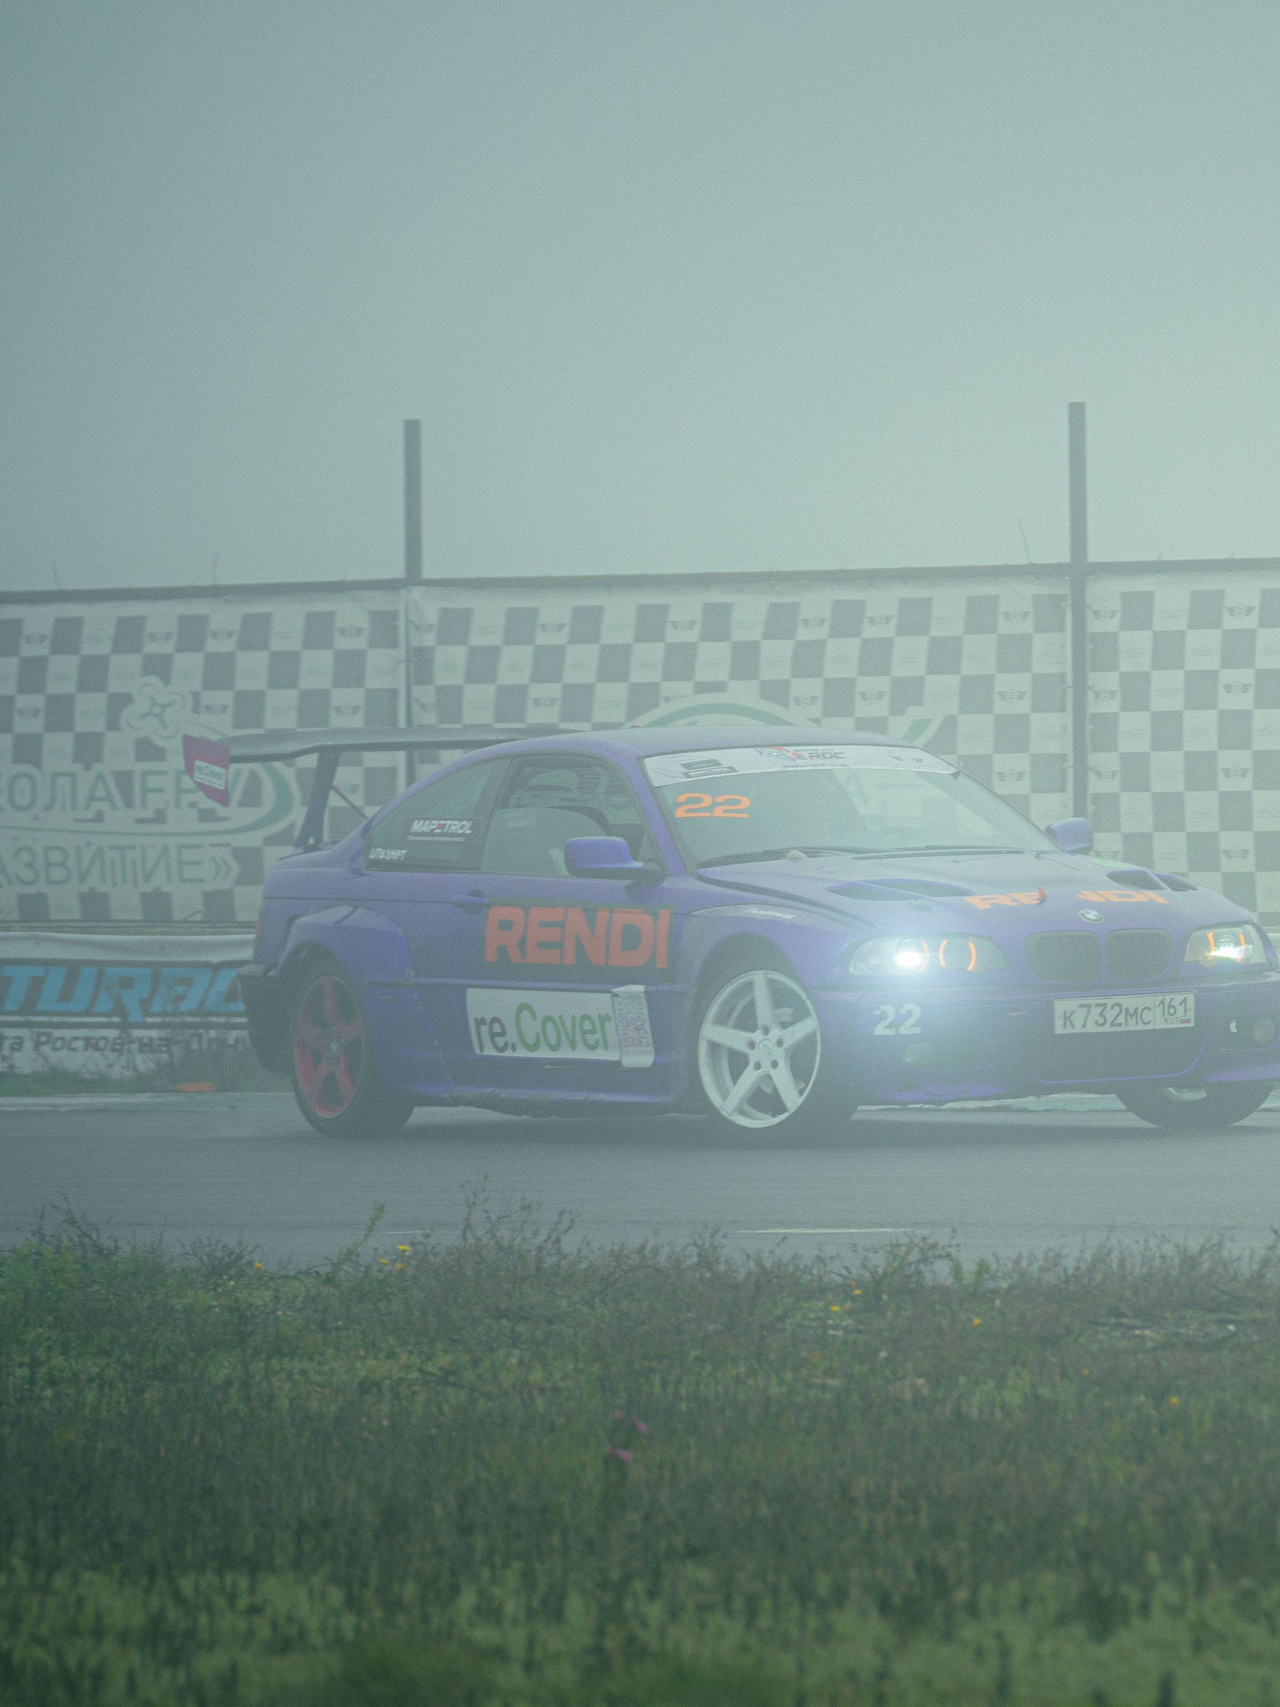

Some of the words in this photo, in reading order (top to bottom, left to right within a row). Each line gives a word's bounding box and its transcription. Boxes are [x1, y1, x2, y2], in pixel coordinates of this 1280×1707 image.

[0, 769, 117, 811] ОЛА
[674, 792, 752, 819] 22
[409, 819, 473, 834] MAPETROL
[484, 905, 672, 969] RENDI
[872, 1002, 922, 1036] 22
[1157, 996, 1189, 1018] 161
[474, 1003, 612, 1054] re.Cover
